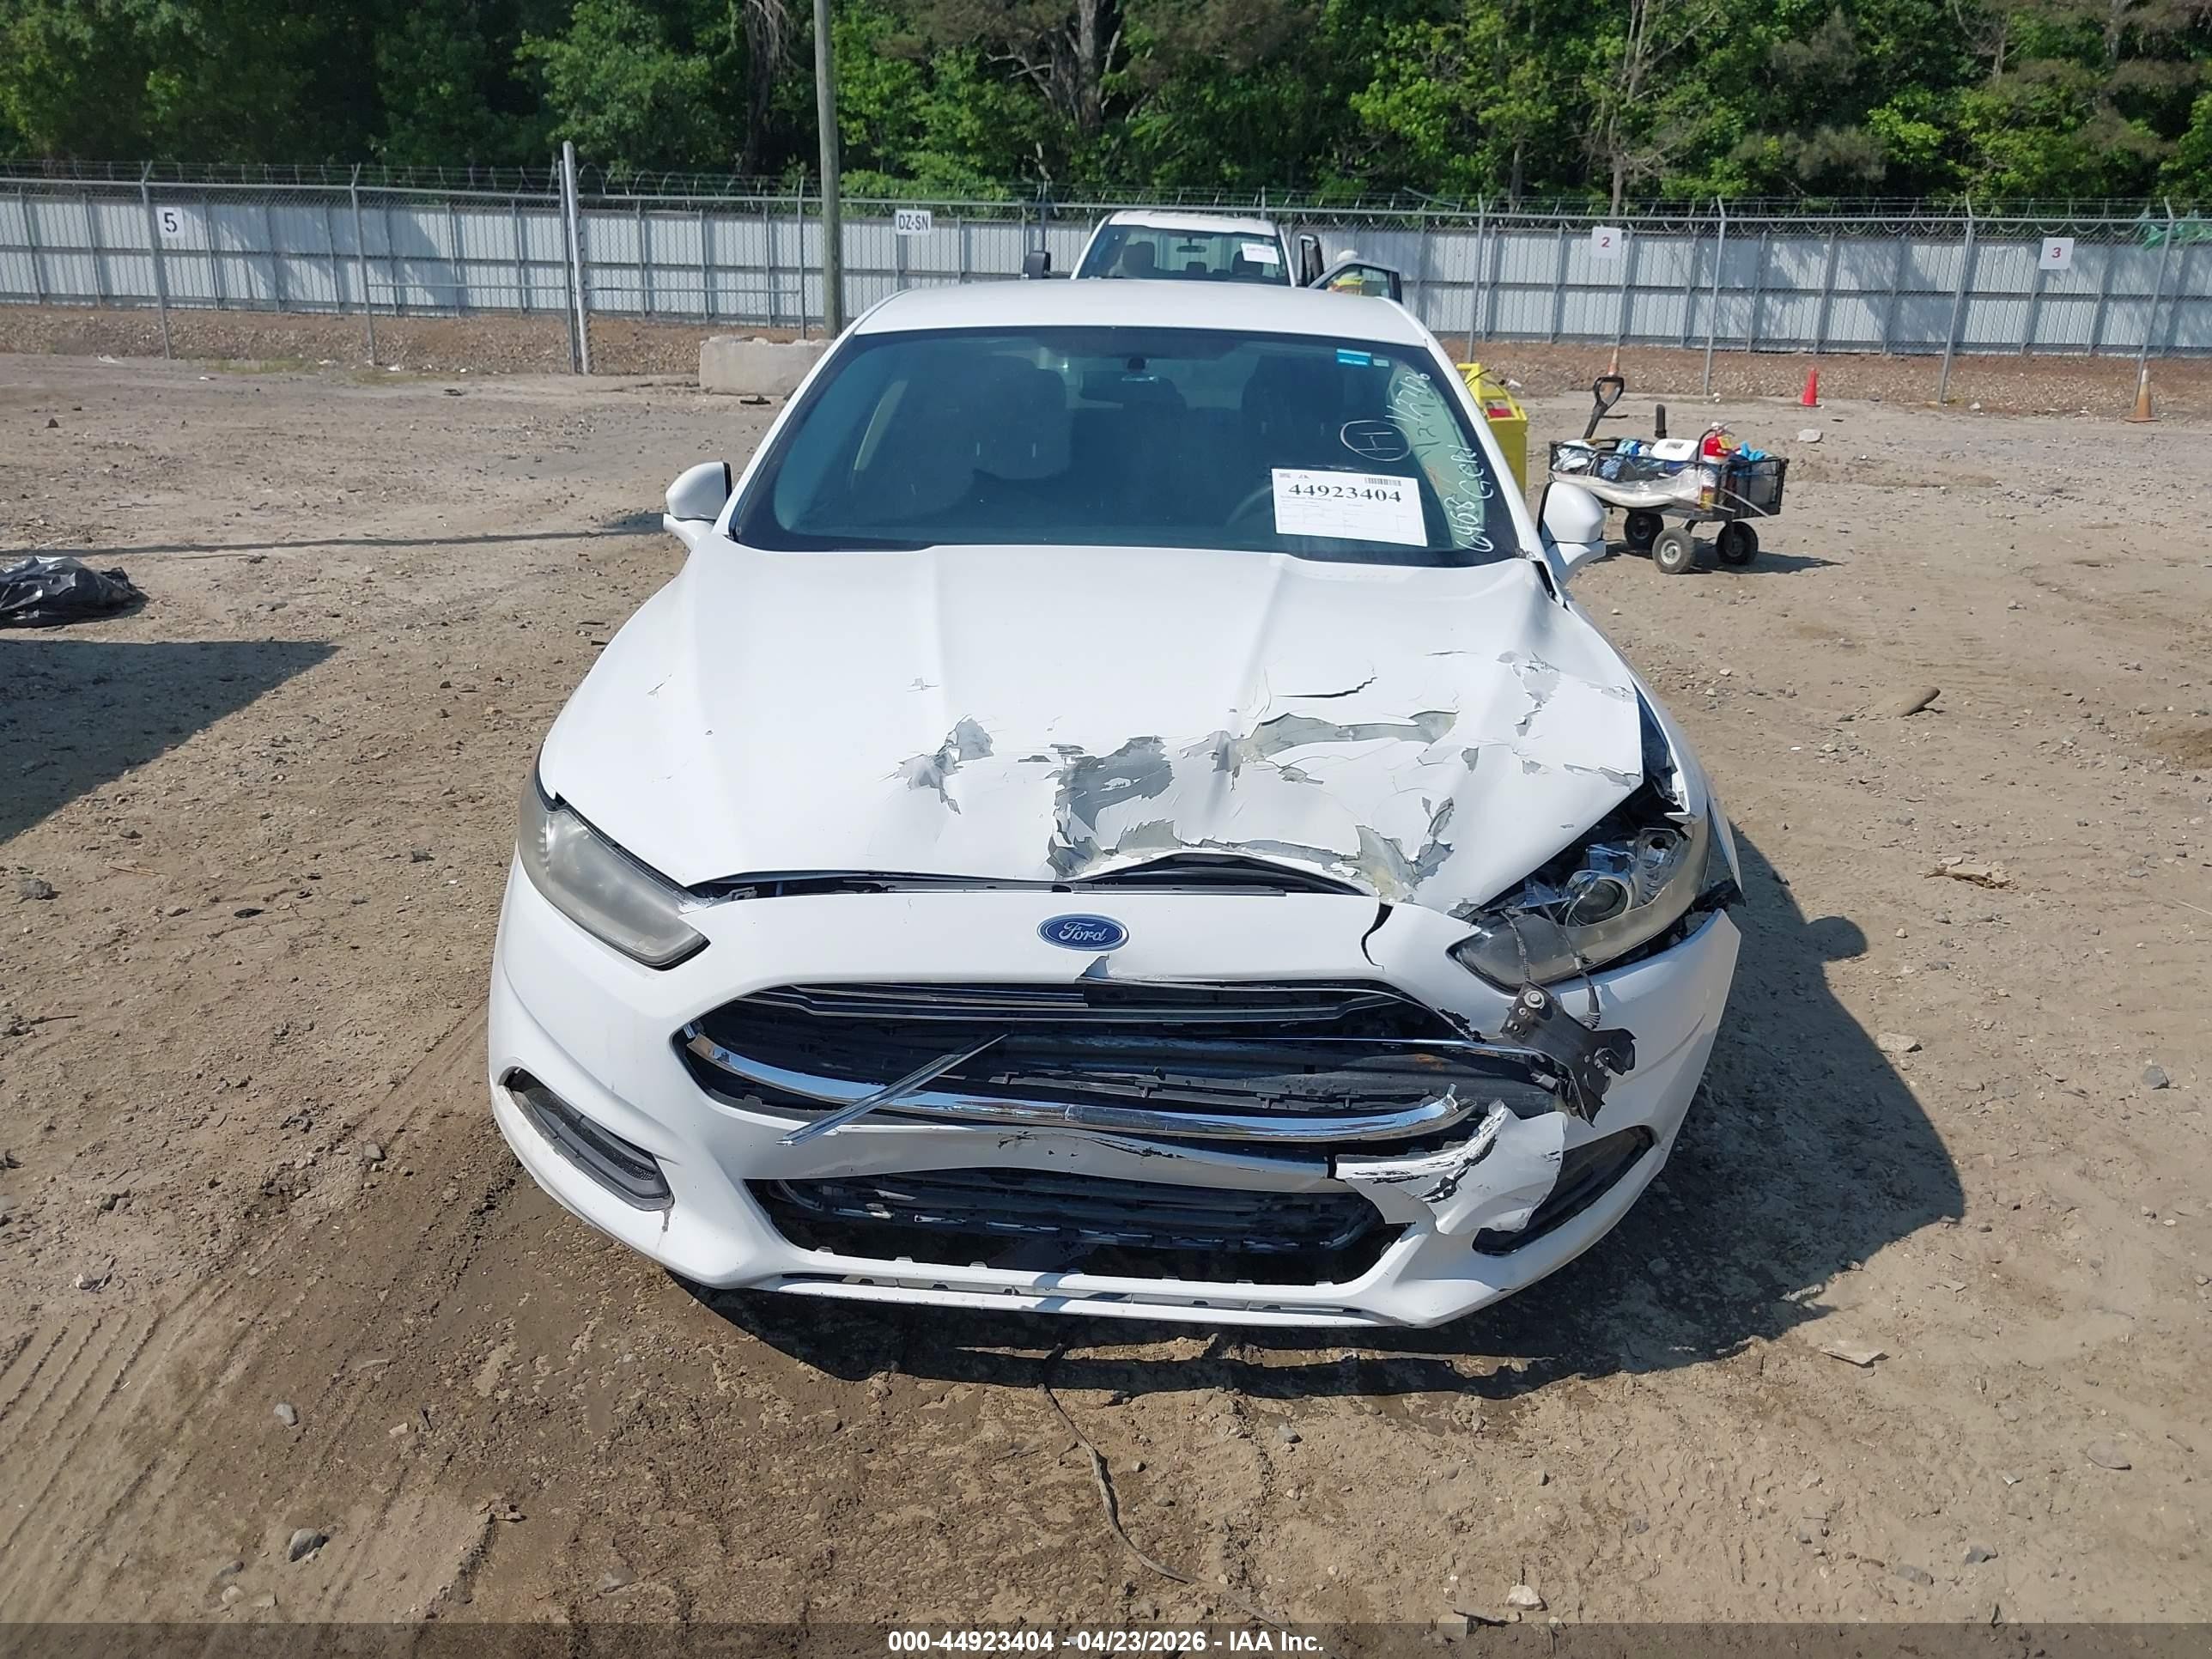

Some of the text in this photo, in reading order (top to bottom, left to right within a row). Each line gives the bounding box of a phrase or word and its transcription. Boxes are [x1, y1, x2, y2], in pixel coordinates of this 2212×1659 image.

[164, 212, 178, 233] 5
[1601, 236, 1611, 248] 2
[2051, 246, 2062, 258] 3
[1287, 483, 1402, 503] 44923404
[1058, 921, 1108, 942] Ford
